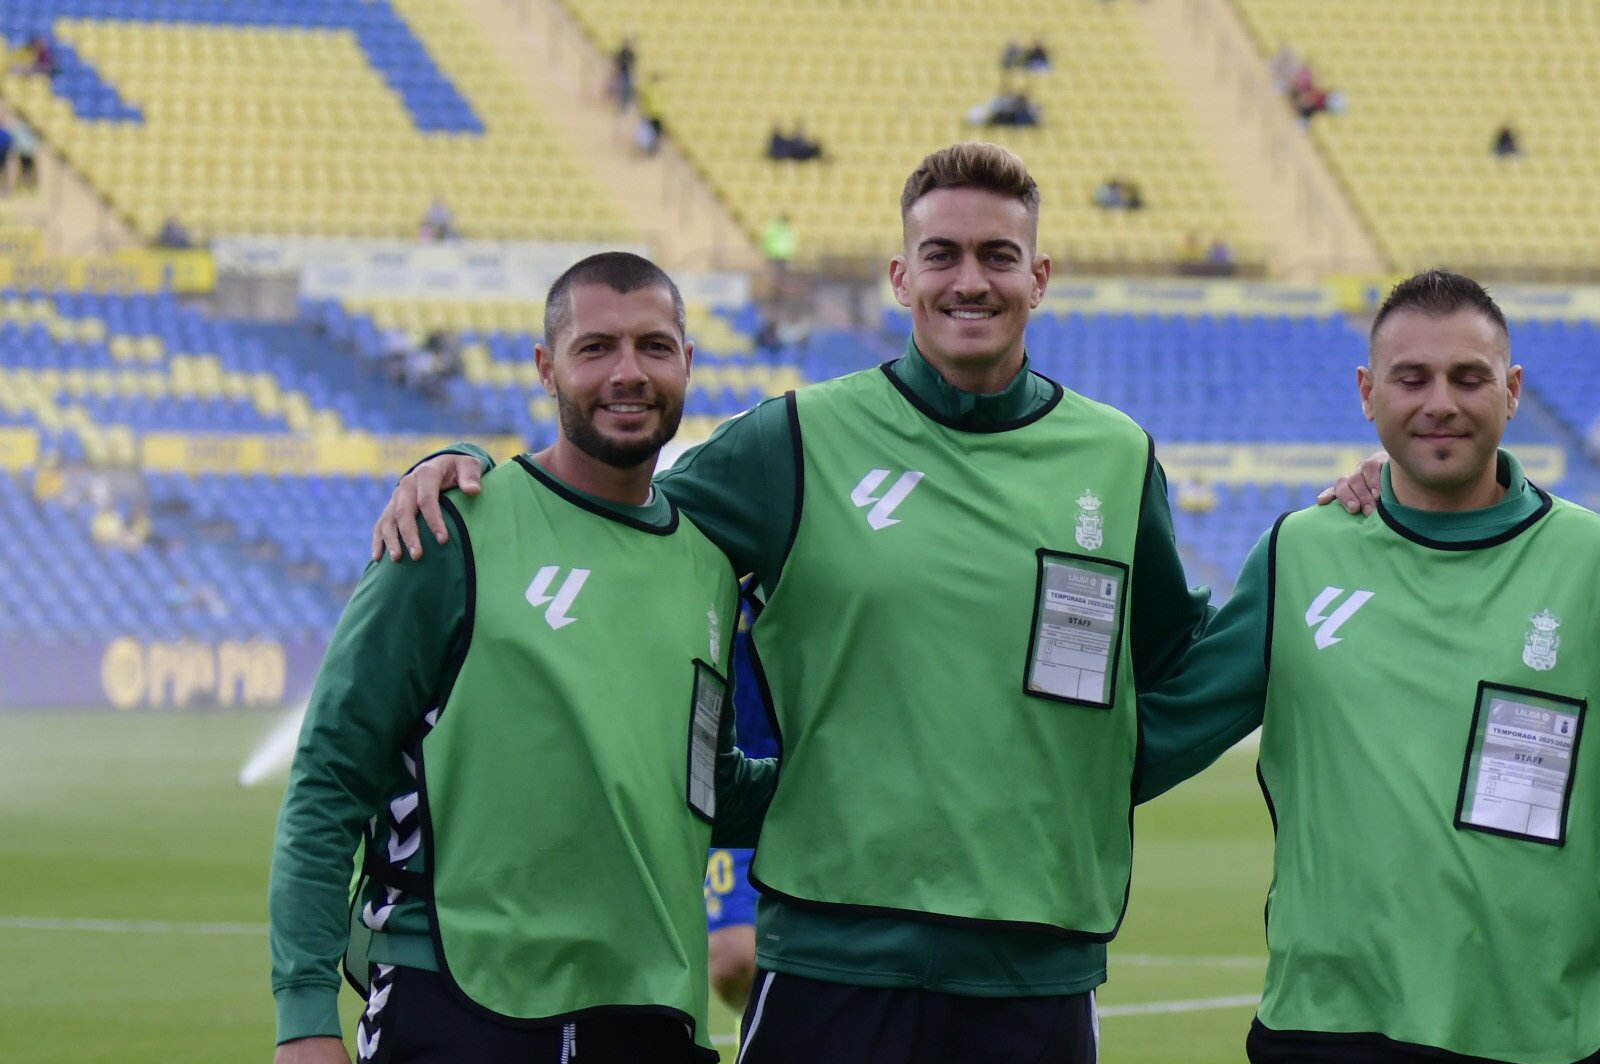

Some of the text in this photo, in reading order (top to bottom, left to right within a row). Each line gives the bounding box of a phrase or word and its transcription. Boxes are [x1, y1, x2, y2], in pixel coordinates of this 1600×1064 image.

[1050, 592, 1086, 605] TEMPORADA
[1067, 616, 1092, 628] STAFF
[1515, 708, 1541, 719] LALIGA
[1492, 727, 1536, 741] TEMPORADA
[1514, 753, 1544, 764] STAFF
